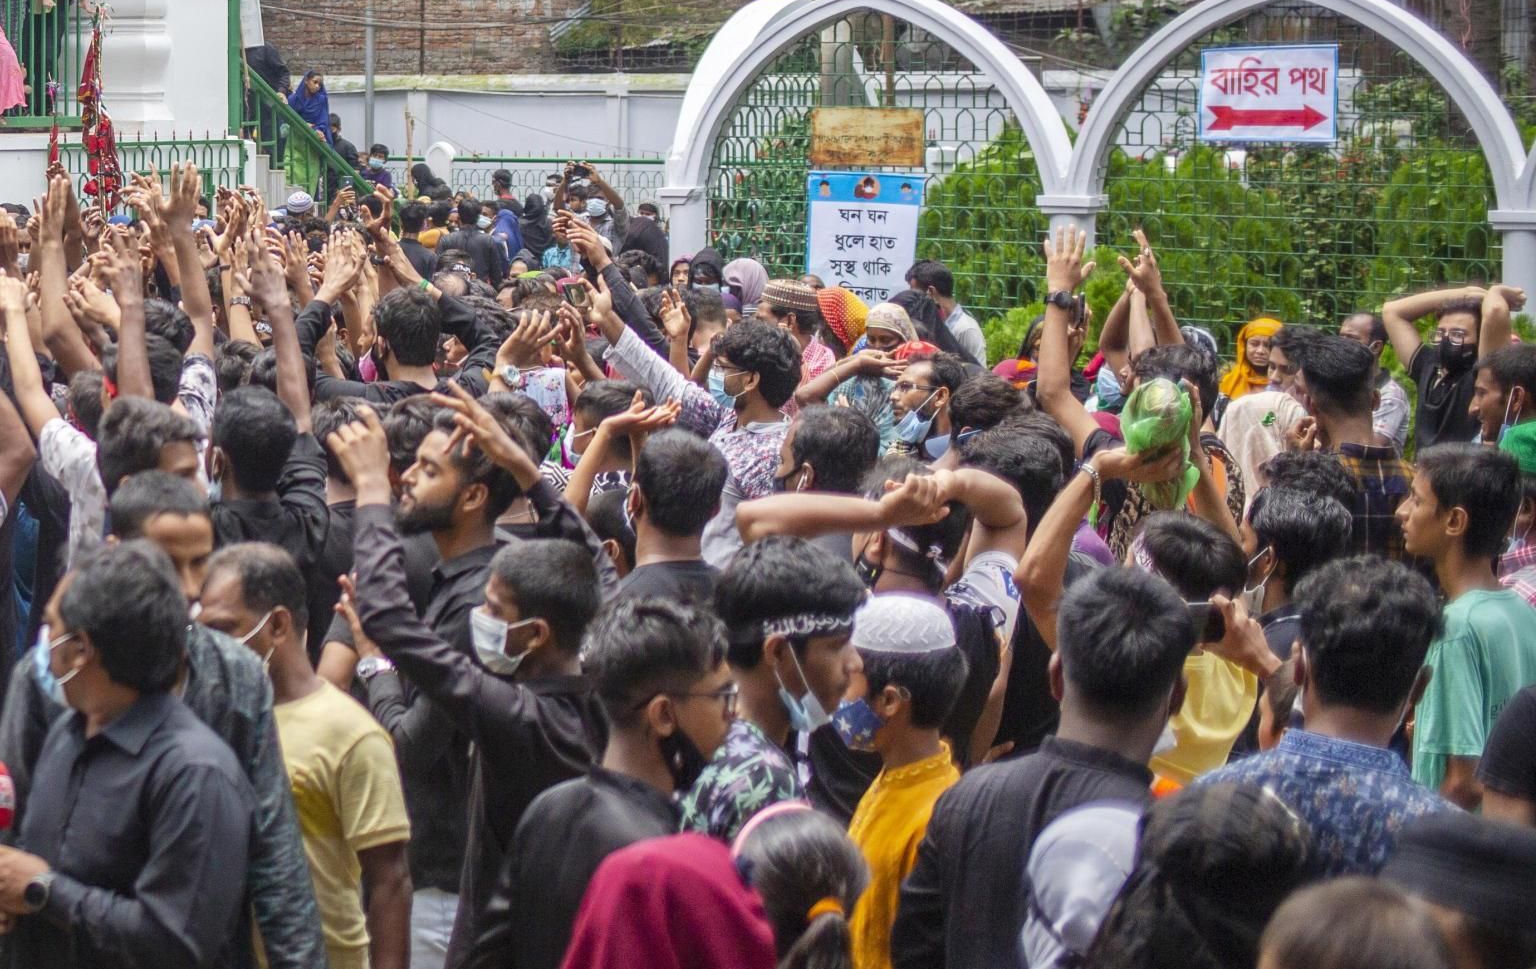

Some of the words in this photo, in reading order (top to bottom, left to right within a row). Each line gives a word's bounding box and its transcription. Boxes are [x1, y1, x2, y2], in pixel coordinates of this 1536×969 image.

[1210, 56, 1280, 98] বাহির
[1288, 67, 1328, 95] পথ
[838, 209, 863, 223] ঘন
[867, 210, 889, 224] ঘন
[835, 234, 865, 252] ধুলে
[869, 236, 897, 251] হাত
[830, 259, 858, 278] সুস্থ
[862, 257, 892, 276] থাকি
